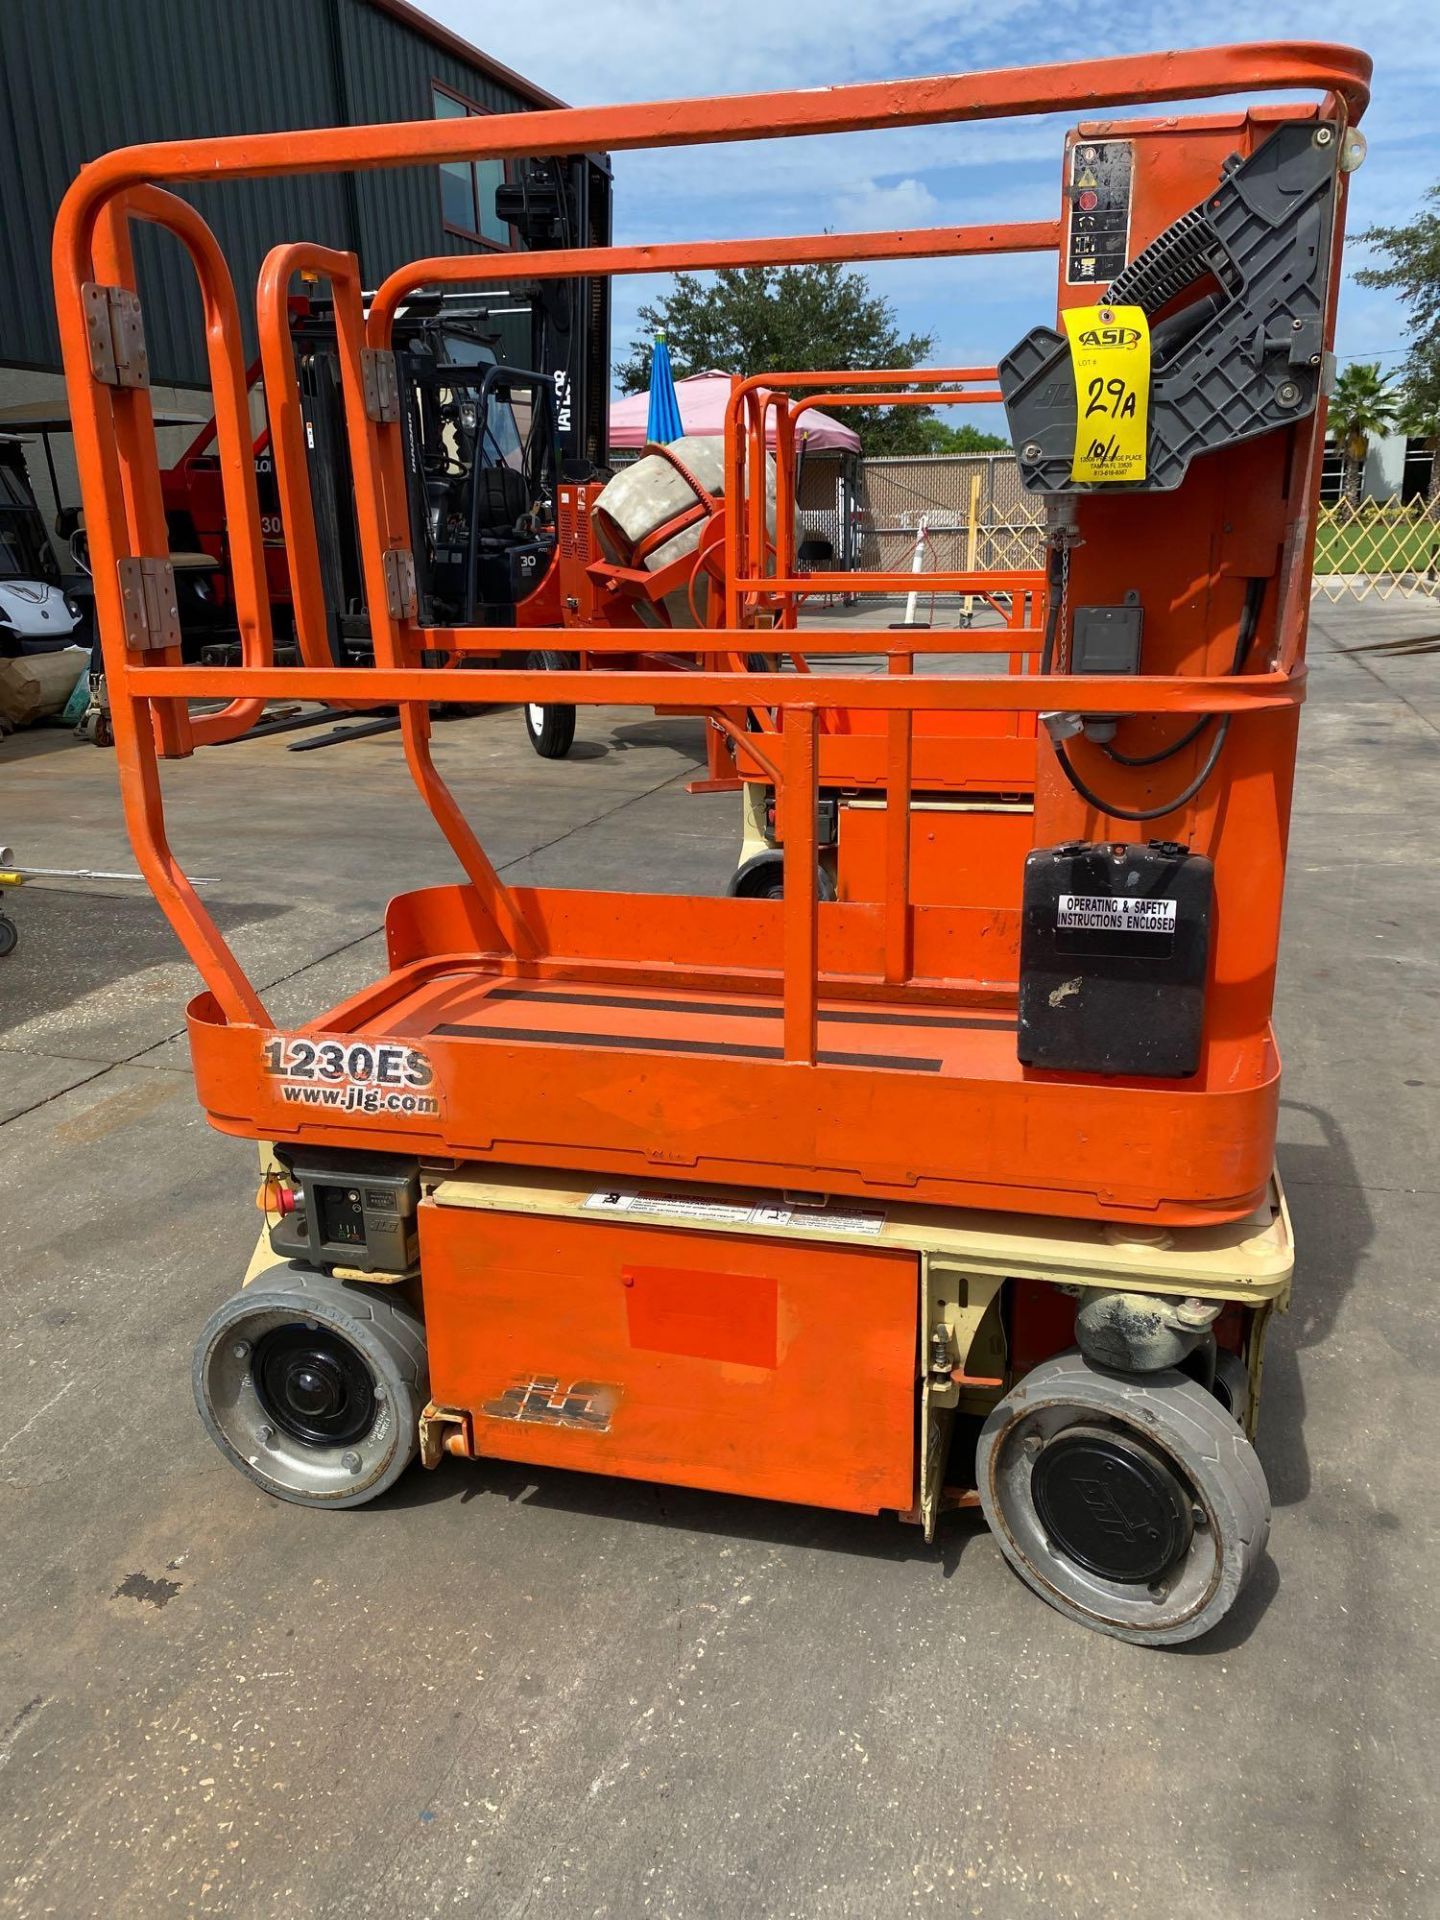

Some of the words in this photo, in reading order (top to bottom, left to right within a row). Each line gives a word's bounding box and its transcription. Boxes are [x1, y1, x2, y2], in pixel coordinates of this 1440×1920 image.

[1085, 376, 1136, 419] 29A
[520, 555, 537, 567] 30
[1066, 897, 1118, 913] OPERATING
[1122, 900, 1130, 914] &
[1134, 901, 1169, 915] SAFETY
[1058, 912, 1122, 928] INSTRUCTIONS
[1126, 915, 1175, 931] ENCLOSED
[263, 1040, 434, 1087] 1230ES
[283, 1086, 439, 1113] www.jlg.com
